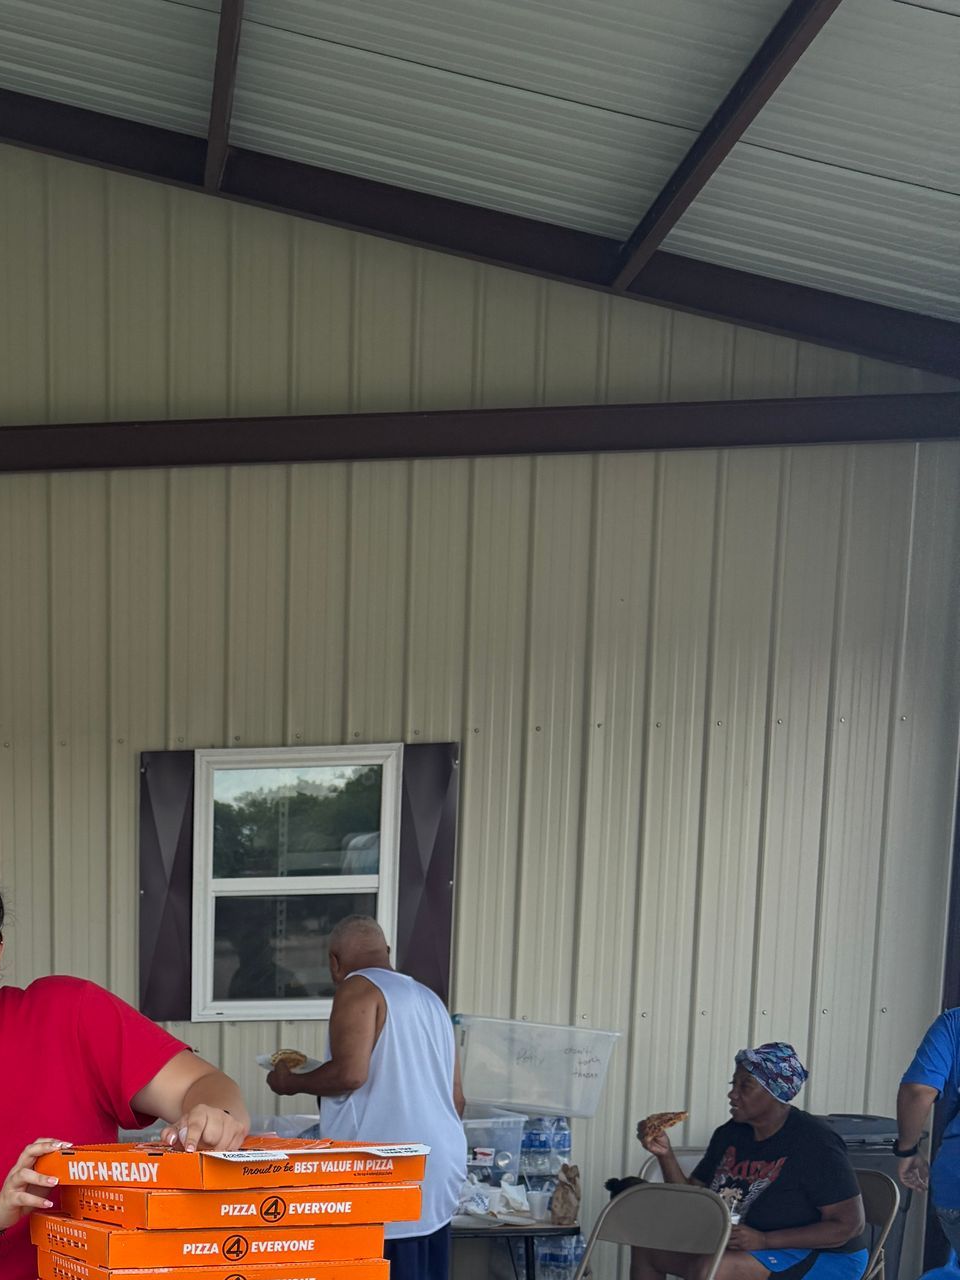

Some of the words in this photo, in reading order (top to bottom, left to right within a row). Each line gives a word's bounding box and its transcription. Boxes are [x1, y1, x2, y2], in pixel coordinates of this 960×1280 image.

[68, 1160, 159, 1183] HOT-N-READY
[243, 1164, 271, 1176] Proud
[272, 1164, 282, 1173] to
[283, 1162, 294, 1172] be
[294, 1161, 320, 1174] BEST
[320, 1160, 352, 1173] VALUE
[353, 1159, 364, 1171] IN
[365, 1159, 394, 1171] PIZZA
[220, 1203, 258, 1217] PIZZA
[261, 1198, 284, 1221] 4
[289, 1201, 352, 1215] EVERYONE
[183, 1242, 219, 1255] PIZZA
[224, 1236, 247, 1259] 4
[251, 1239, 315, 1253] EVERYONE
